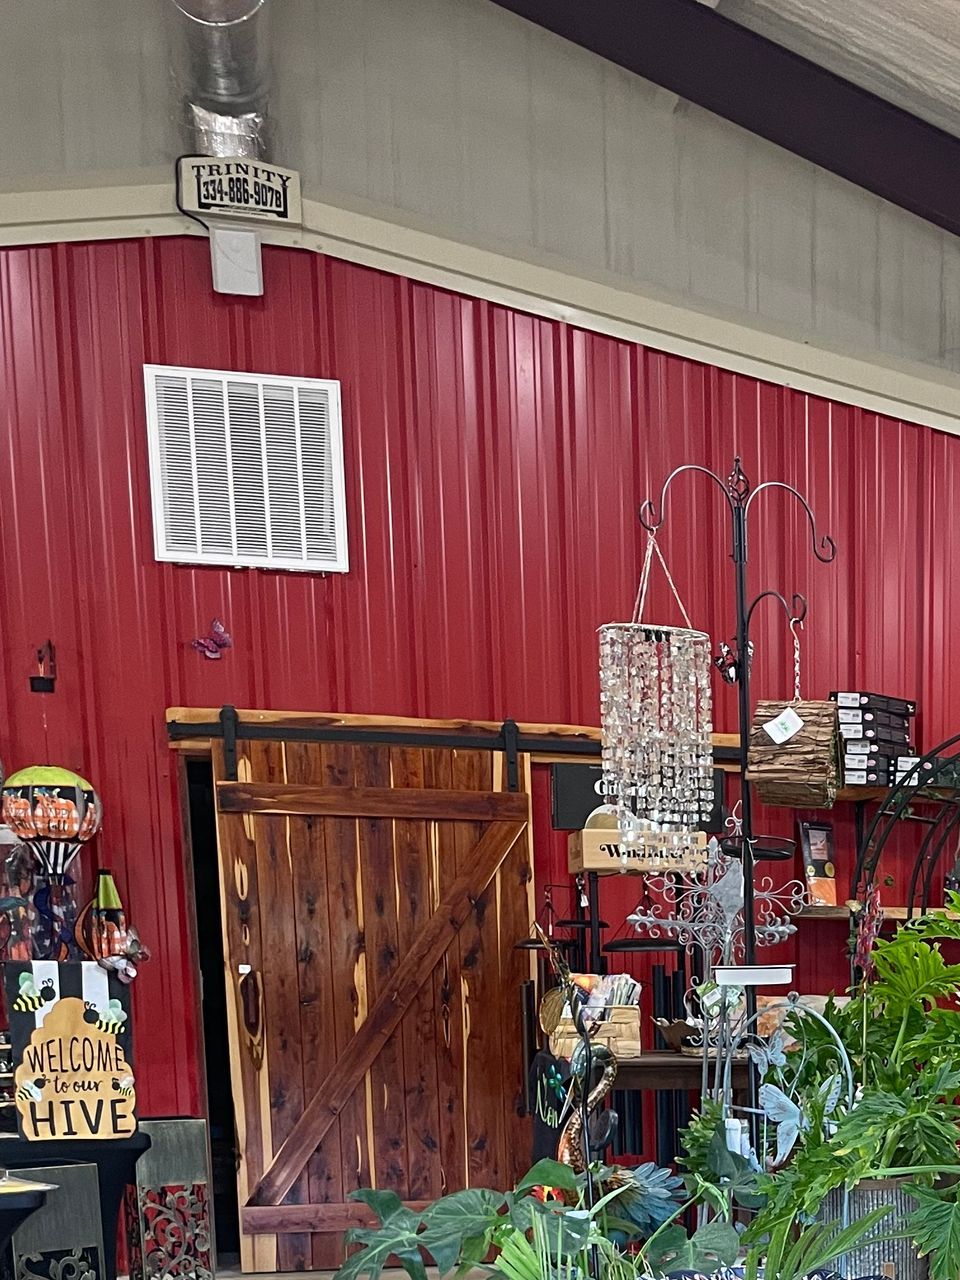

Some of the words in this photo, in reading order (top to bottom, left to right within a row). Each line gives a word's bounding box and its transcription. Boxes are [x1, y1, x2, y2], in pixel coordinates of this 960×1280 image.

[191, 163, 291, 187] TRINITY
[202, 177, 283, 209] 334-886-9078
[26, 1036, 126, 1073] WELCOME
[53, 1075, 71, 1094] to
[73, 1080, 104, 1093] our
[29, 1098, 132, 1137] HIVE
